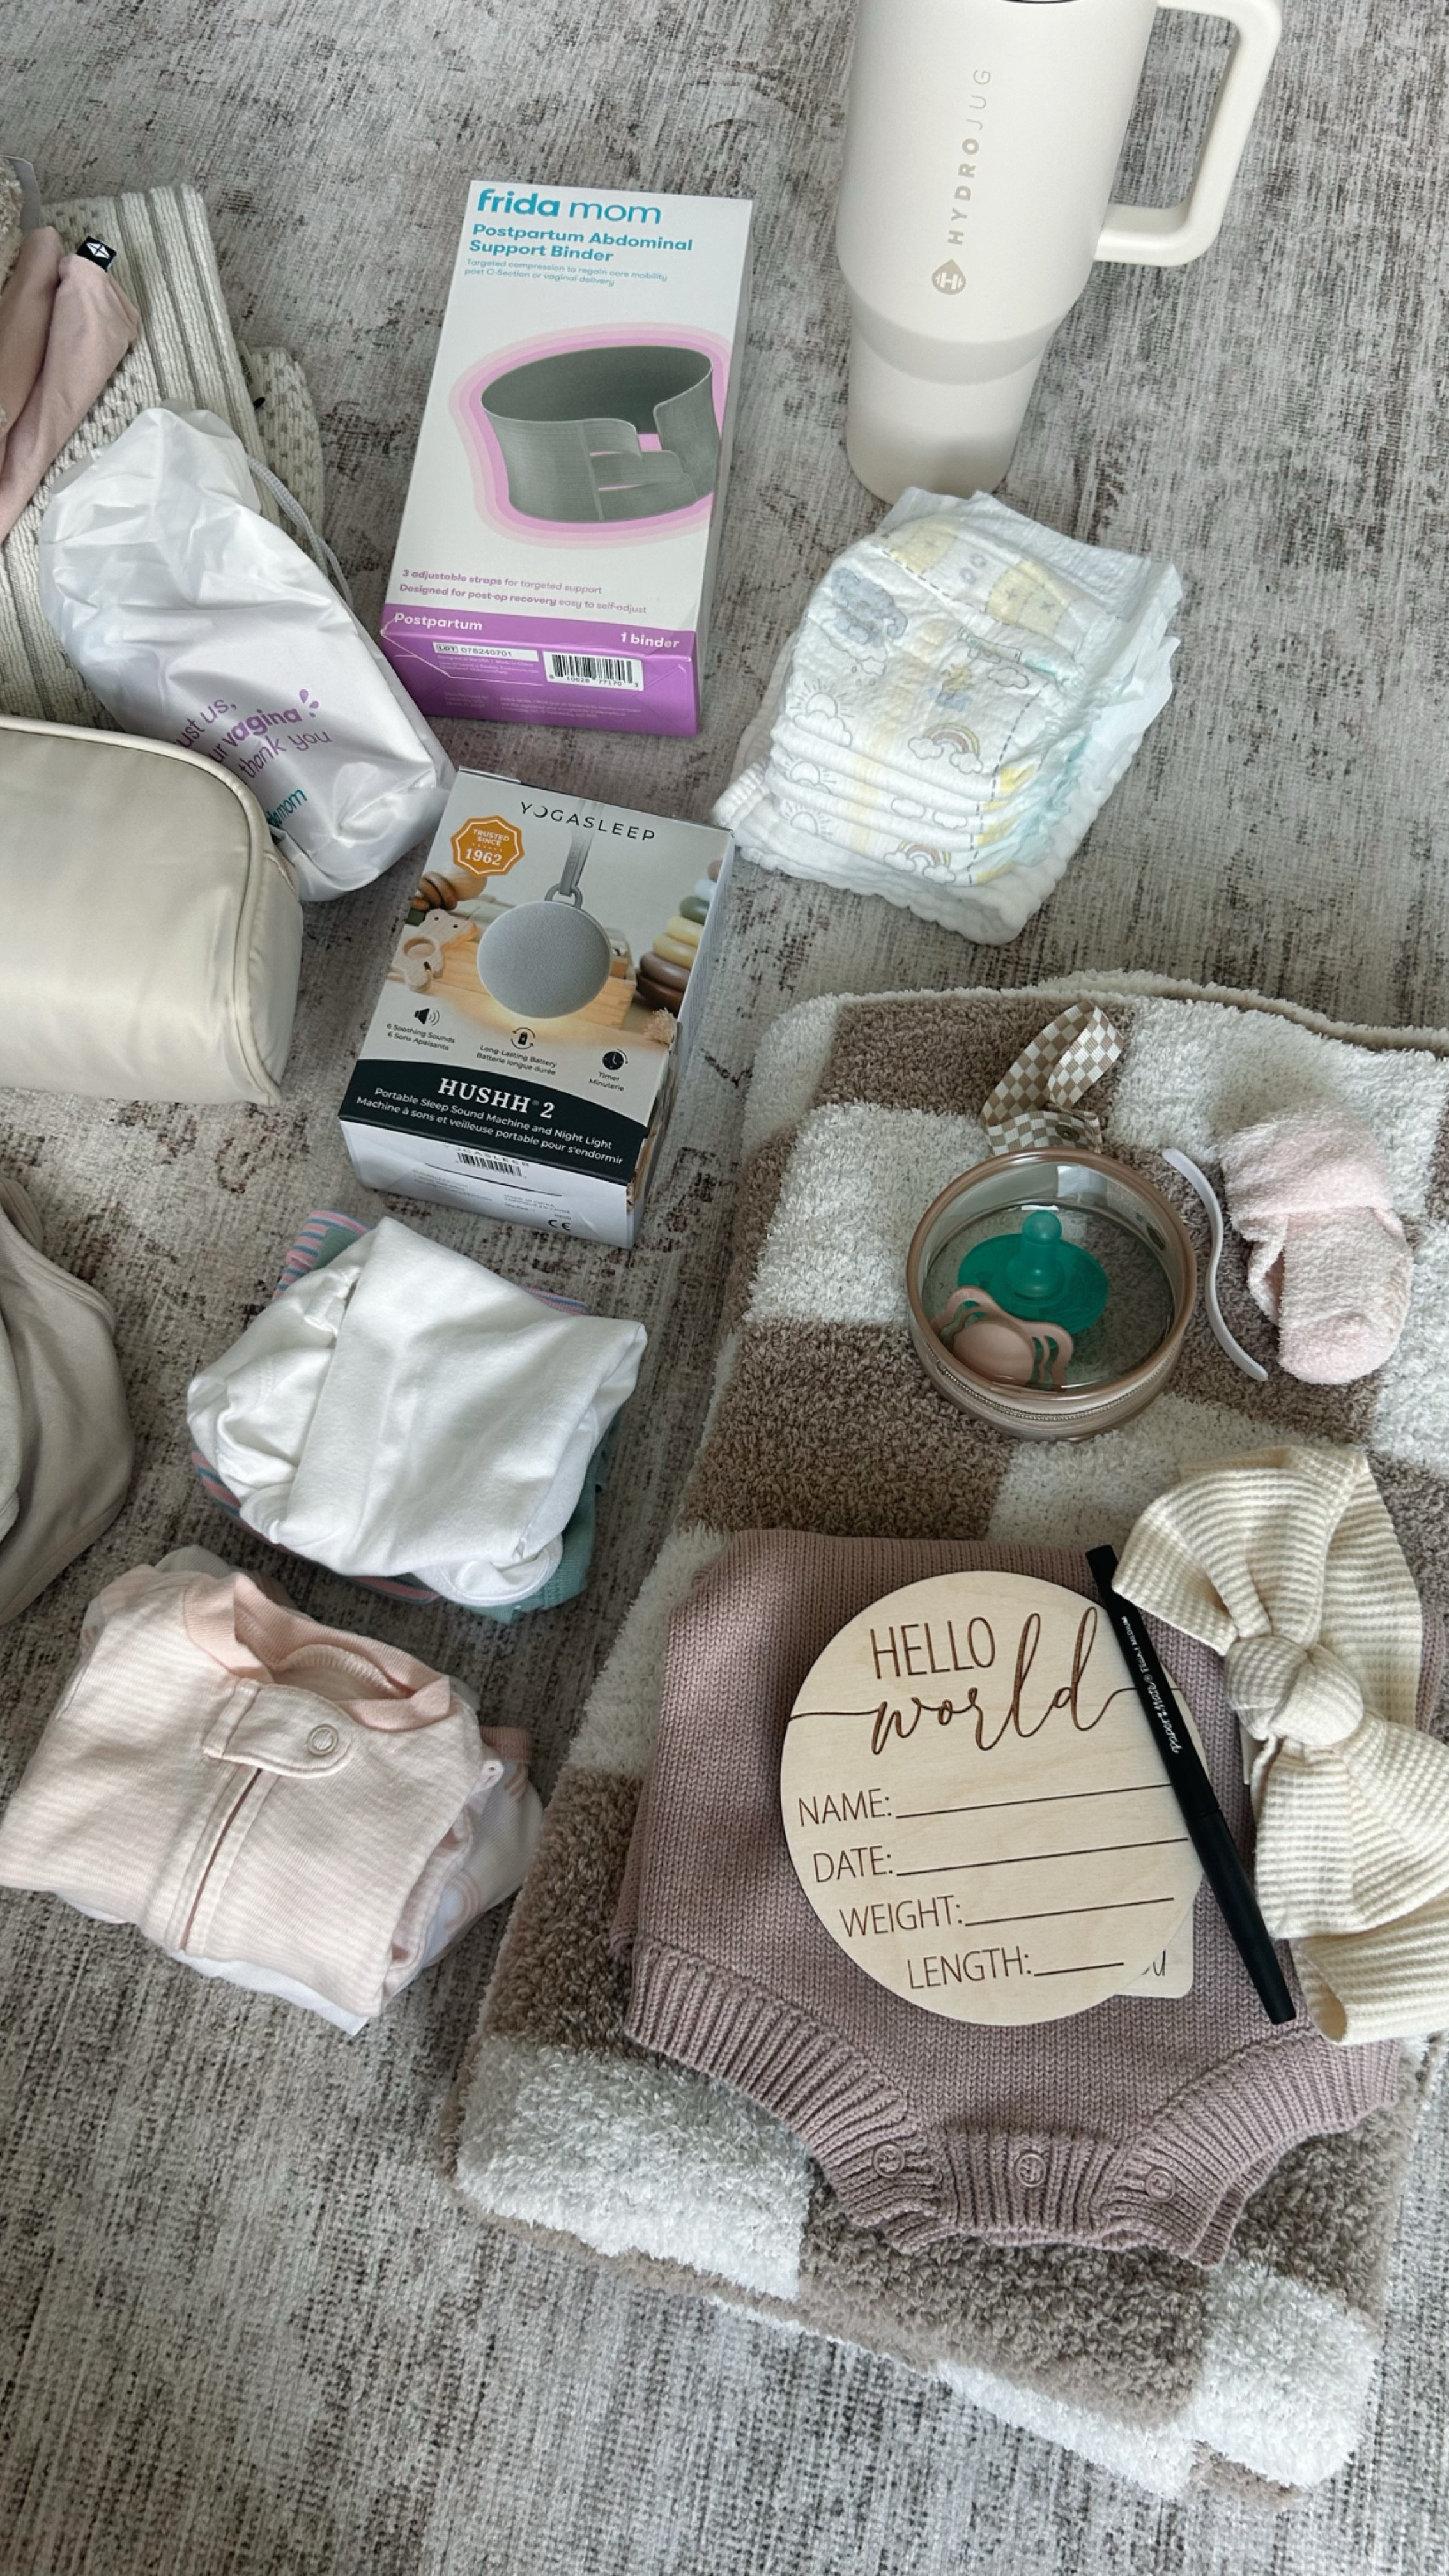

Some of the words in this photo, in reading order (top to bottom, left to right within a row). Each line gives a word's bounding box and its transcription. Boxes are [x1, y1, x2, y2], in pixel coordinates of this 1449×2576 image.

[947, 69, 992, 245] HYDROJUG
[477, 188, 560, 217] frida
[569, 201, 661, 224] mom
[473, 223, 585, 243] Postpartum
[589, 232, 693, 251] Abdominal
[469, 240, 546, 257] Support
[551, 245, 613, 262] Binder
[467, 258, 507, 268] Targeted
[509, 262, 565, 272] compression
[567, 264, 576, 273] to
[578, 266, 607, 276] regain
[631, 272, 668, 282] mobility
[486, 268, 530, 278] C-Section
[544, 273, 577, 282] vaginal
[579, 276, 615, 287] delivery
[411, 571, 466, 582] adjustable
[469, 576, 502, 586] straps
[521, 580, 563, 590] targeted
[564, 584, 602, 594] support
[400, 583, 448, 595] Designed
[451, 588, 466, 597] for
[468, 590, 507, 602] post-op
[510, 595, 556, 606] recovery
[558, 599, 581, 610] easy
[597, 602, 647, 614] self-adjust
[394, 612, 482, 631] Postpartum
[621, 632, 627, 642] 1
[631, 634, 680, 648] binder
[175, 717, 205, 749] ust
[200, 699, 237, 724] us,
[208, 743, 228, 763] ur
[222, 709, 303, 747] vagina
[238, 735, 286, 778] thank
[288, 731, 332, 751] you
[519, 801, 656, 841] YOGASLEEP
[473, 829, 510, 841] TRUSTED
[477, 836, 501, 847] SINCE
[465, 848, 502, 866] 1962
[394, 1024, 426, 1038] Soothing
[427, 1032, 455, 1043] Sounds
[394, 1032, 412, 1041] Sons
[413, 1038, 448, 1051] Apaisants
[476, 1053, 505, 1064] Batterie
[507, 1059, 533, 1070] longue
[534, 1066, 556, 1076] durée
[480, 1045, 528, 1062] Long-Lasting
[530, 1056, 557, 1068] Battery
[588, 1078, 625, 1092] Minuterie
[598, 1071, 620, 1082] Timer
[374, 1087, 418, 1104] Portable
[420, 1098, 448, 1112] Sleep
[450, 1105, 485, 1120] Sound
[486, 1112, 530, 1130] Machine
[532, 1124, 552, 1135] and
[555, 1129, 583, 1143] Night
[586, 1136, 613, 1150] Light
[540, 1101, 555, 1119] 2
[357, 1096, 401, 1114] Machine
[402, 1107, 410, 1115] à
[411, 1110, 435, 1121] sons
[436, 1116, 447, 1124] et
[450, 1119, 494, 1135] veilleuse
[495, 1130, 539, 1145] portable
[540, 1139, 566, 1151] pour
[568, 1146, 624, 1165] s'endormir
[870, 1617, 995, 1680] HELLO
[856, 1606, 1115, 1755] world
[799, 1788, 892, 1827] NAME:
[813, 1845, 893, 1883] DATE:
[839, 1894, 962, 1938] WEIGHT:
[907, 1945, 1031, 1989] LENGTH:
